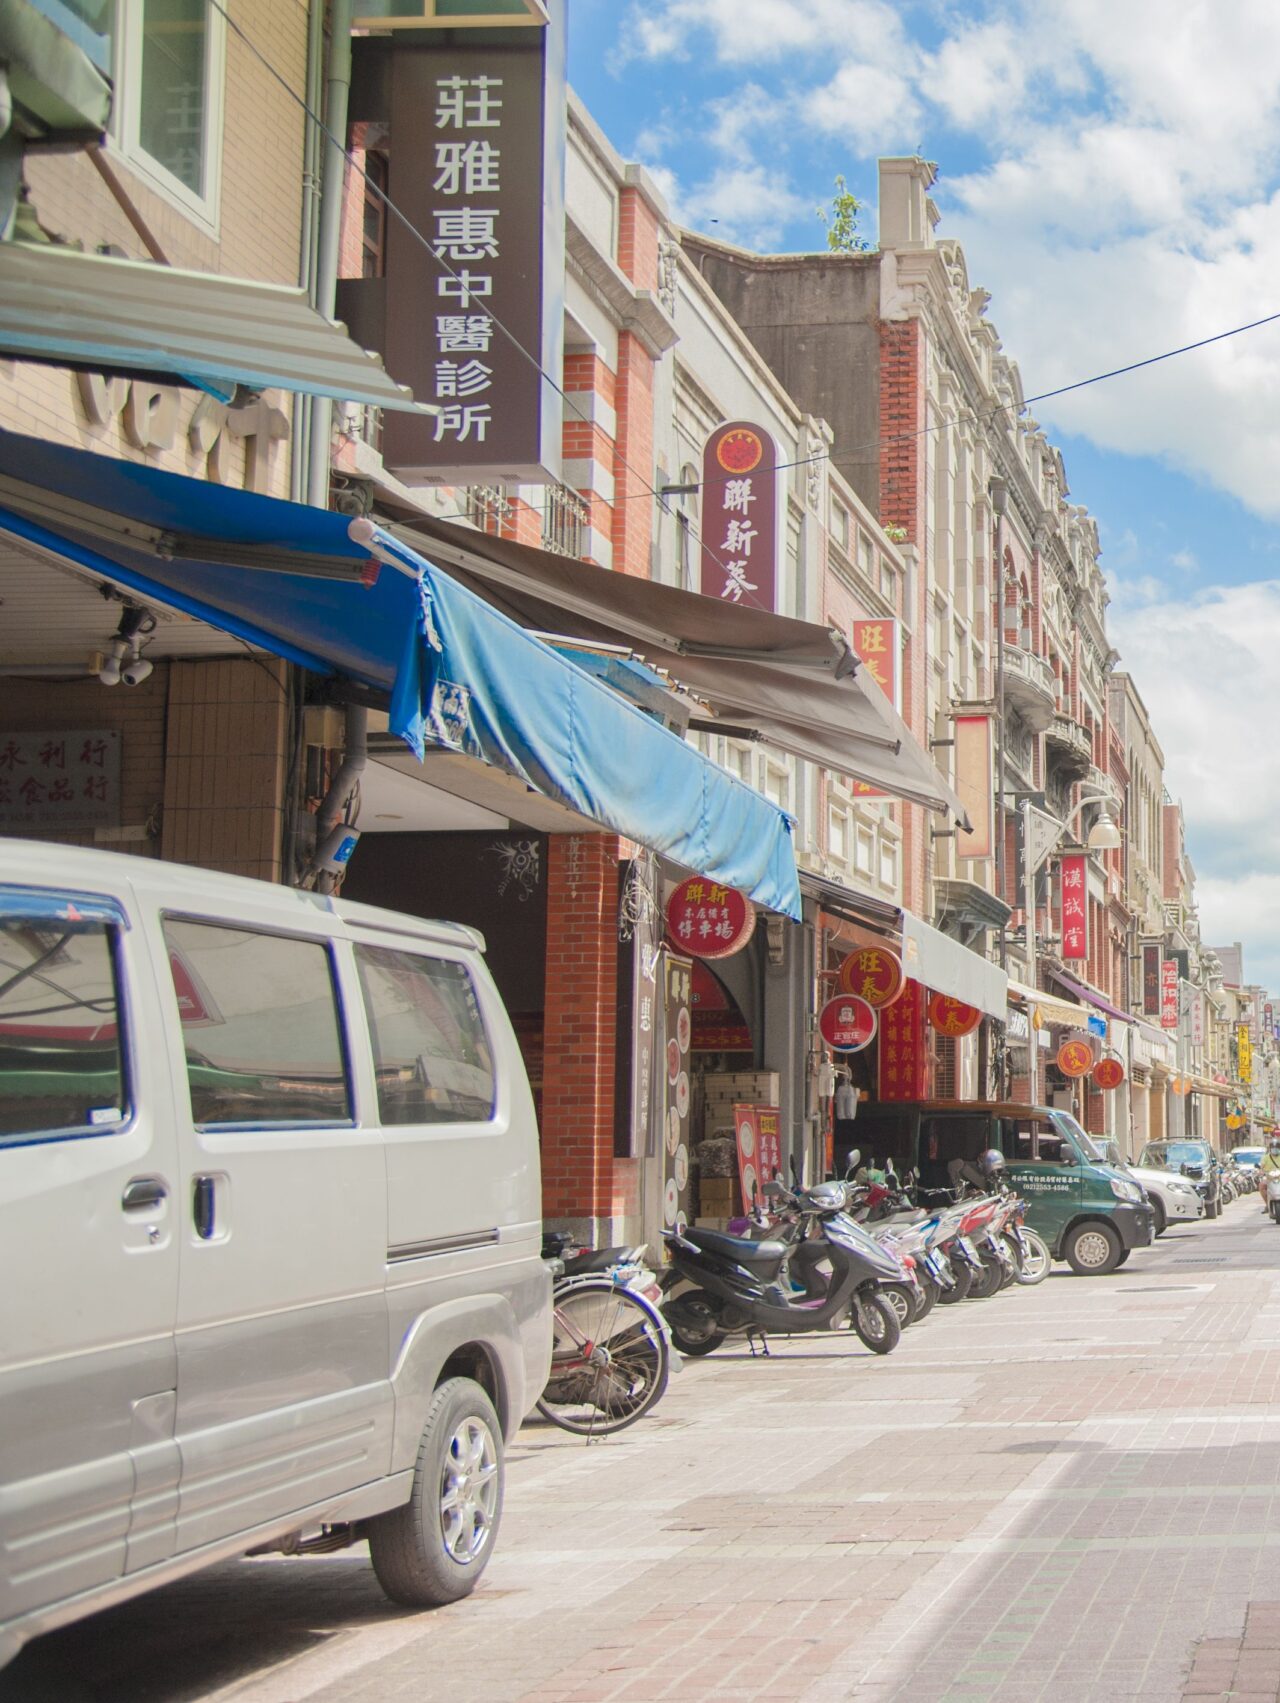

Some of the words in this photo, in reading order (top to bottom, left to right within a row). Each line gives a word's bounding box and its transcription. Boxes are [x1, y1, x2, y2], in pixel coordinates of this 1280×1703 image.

[432, 75, 503, 443] 莊雅惠中醫診所
[678, 920, 734, 939] 停車場
[1063, 868, 1084, 947] 漢誠堂
[859, 951, 886, 1001] 旺泰
